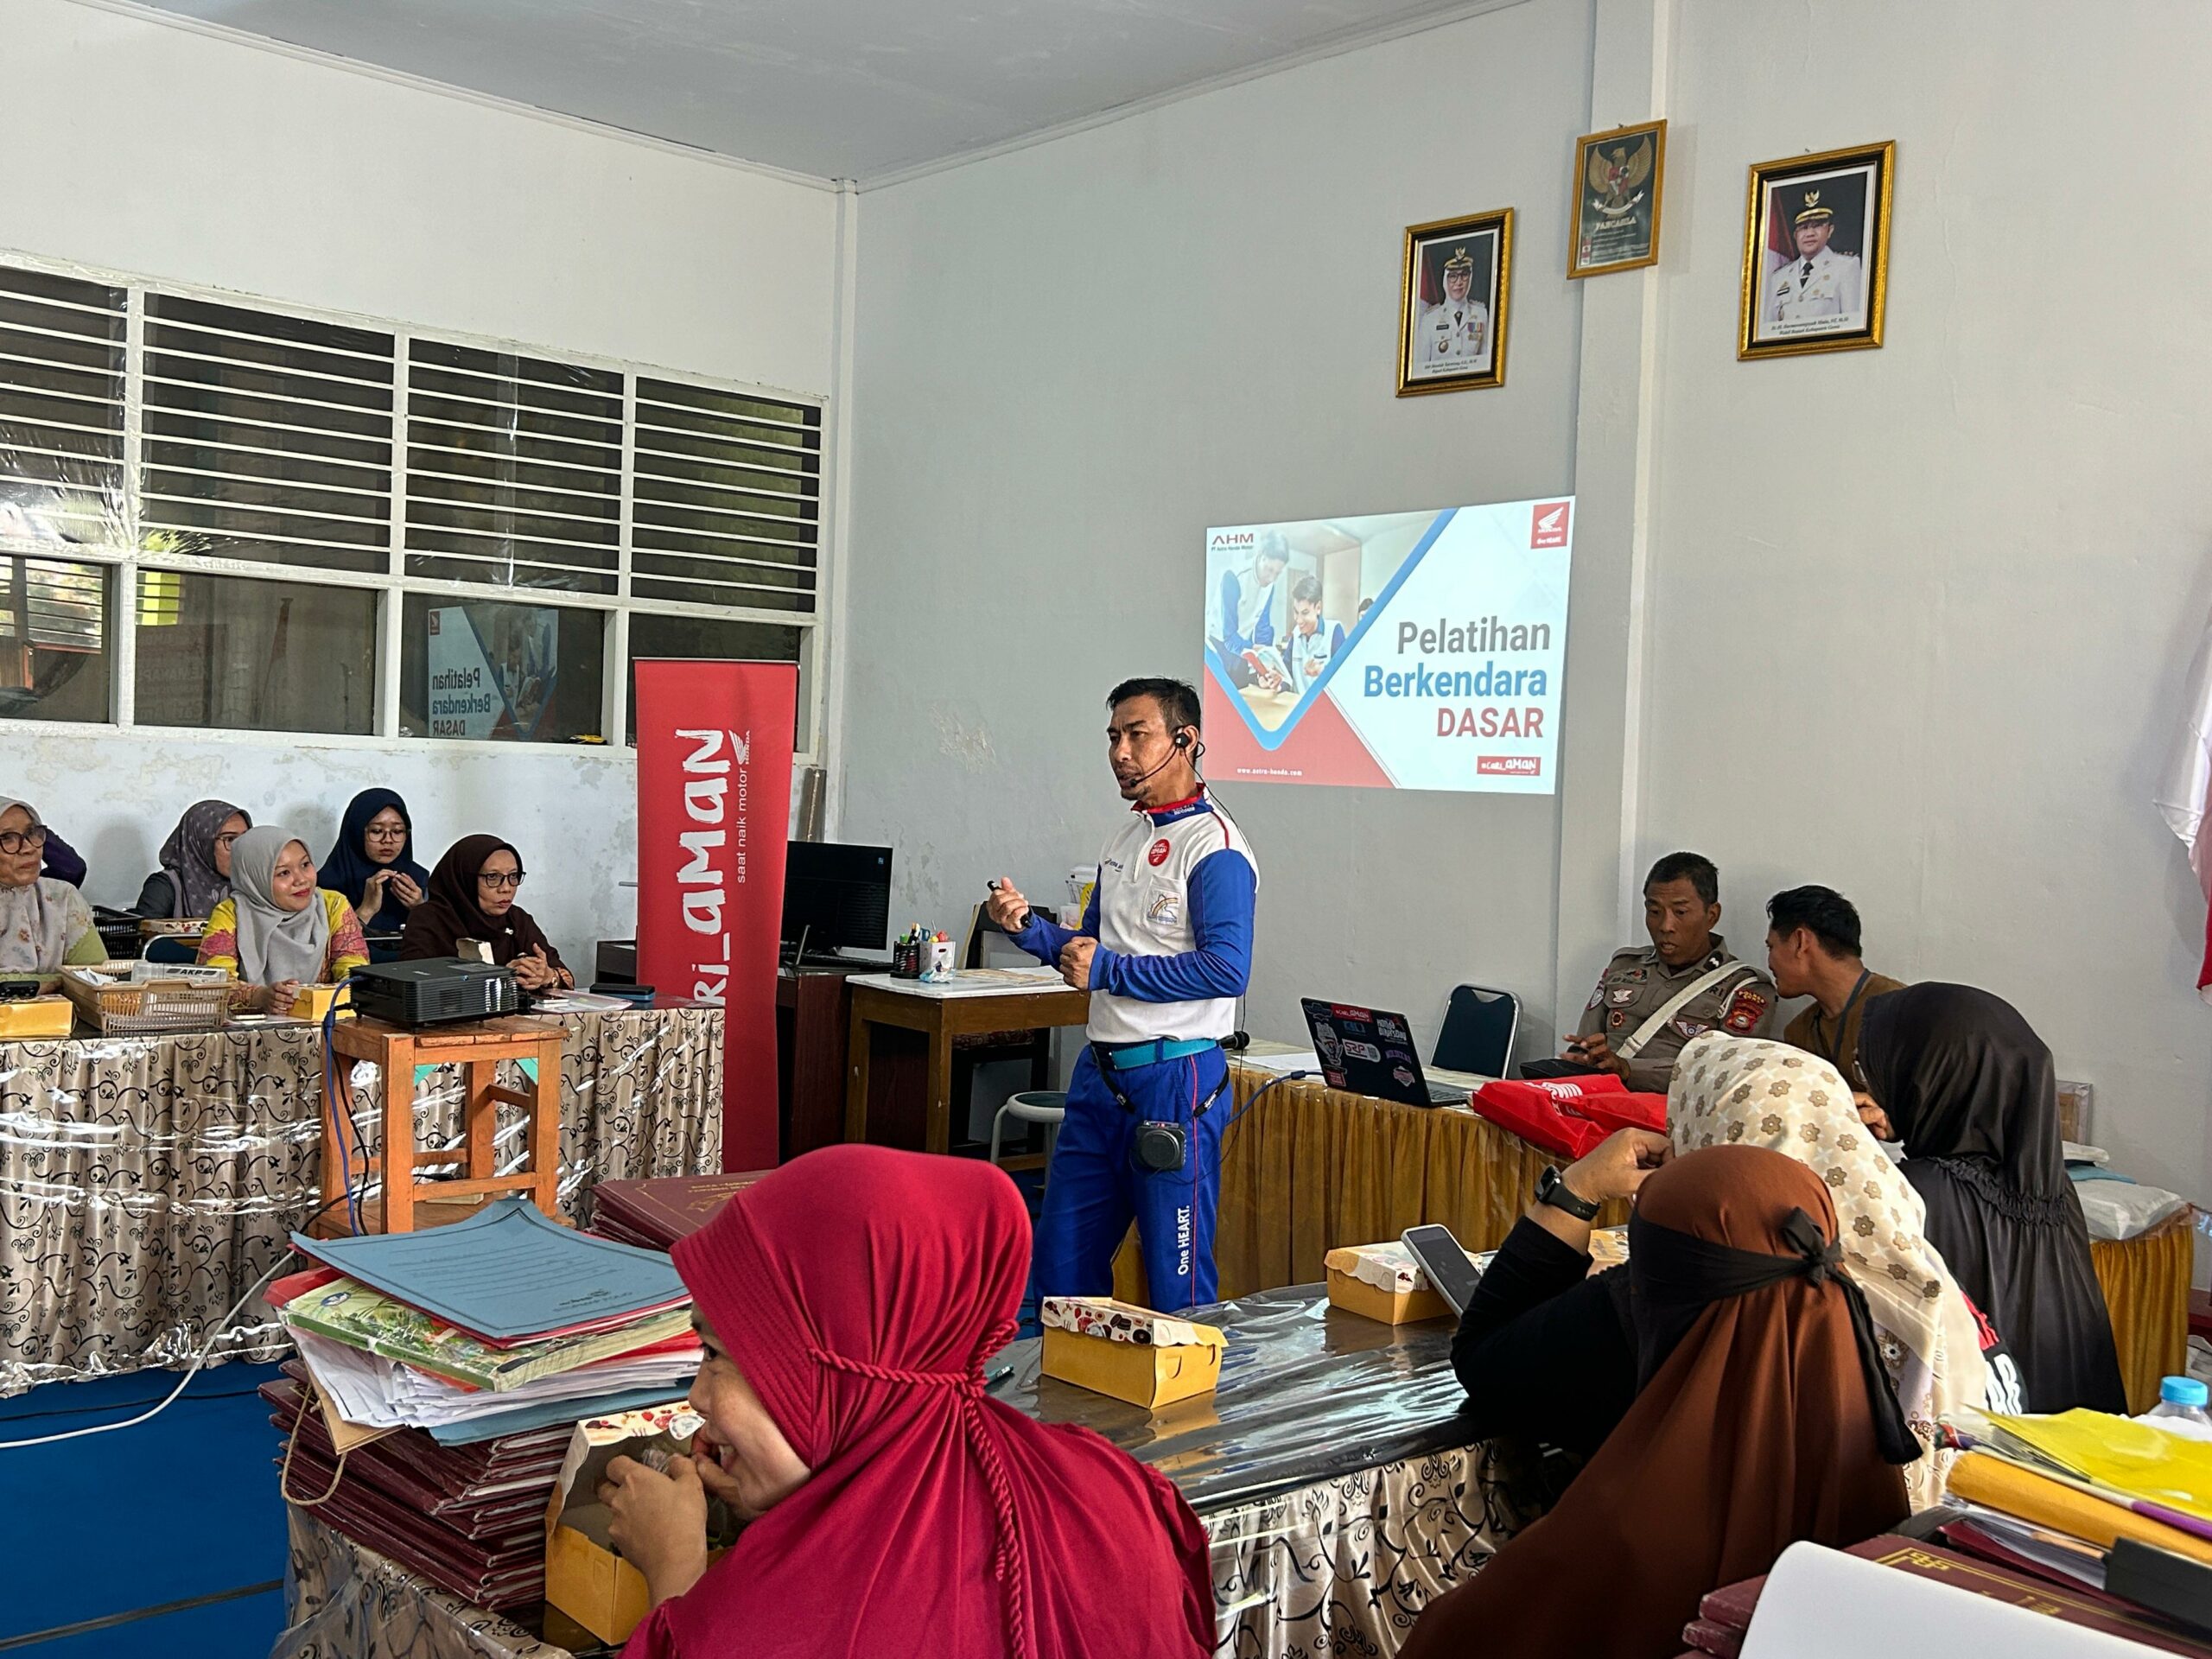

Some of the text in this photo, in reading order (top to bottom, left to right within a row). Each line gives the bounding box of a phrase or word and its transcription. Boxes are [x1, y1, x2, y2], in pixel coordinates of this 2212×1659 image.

[1212, 532, 1254, 545] AHM
[1397, 615, 1551, 654] Pelatihan
[1363, 660, 1548, 697] Berkendara
[1436, 707, 1545, 738] DASAR
[736, 767, 747, 883] saat naik motor
[1178, 1205, 1190, 1276] One HEART.
